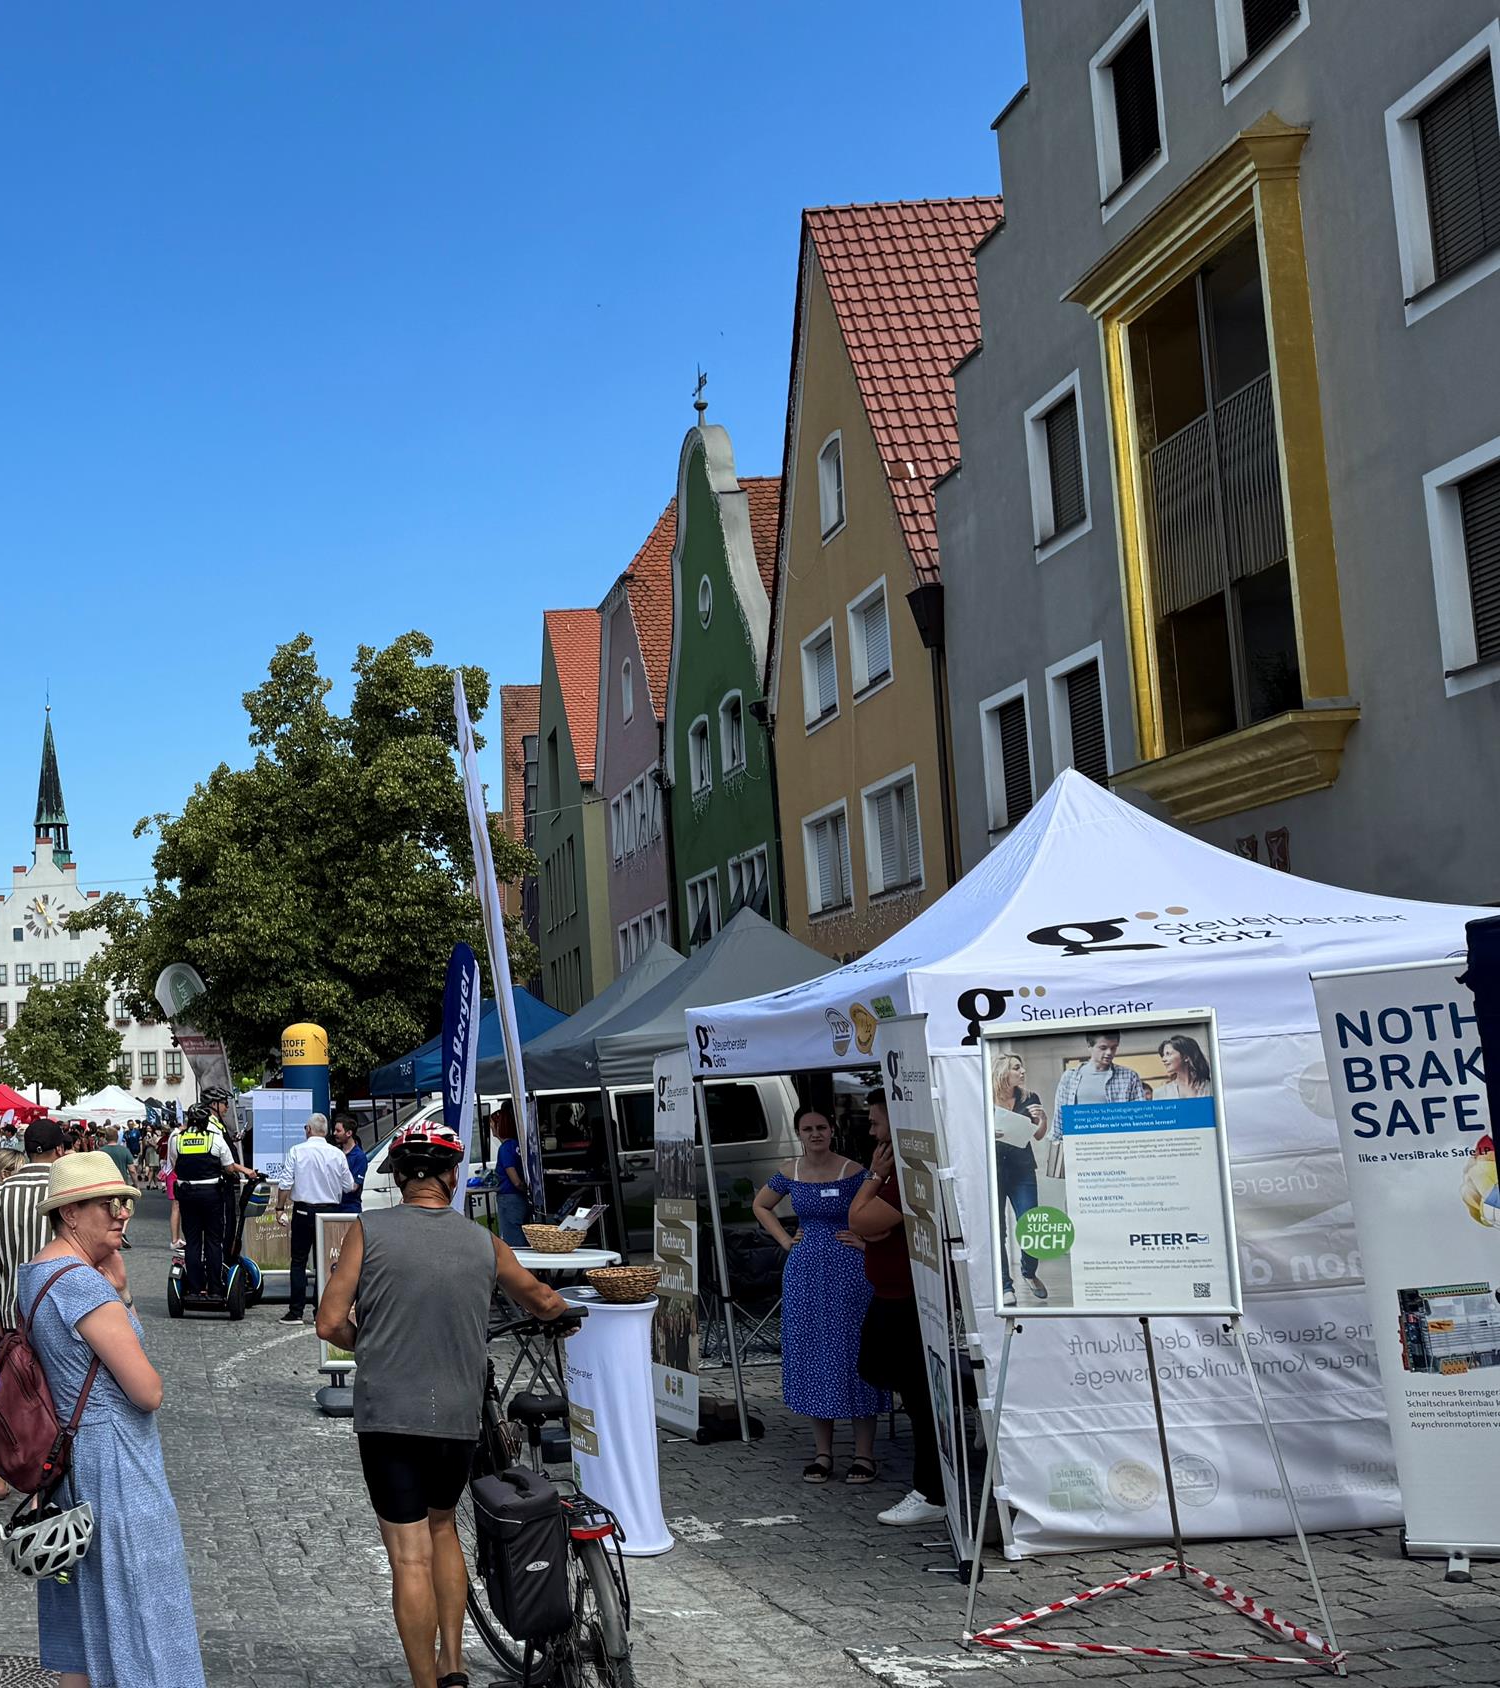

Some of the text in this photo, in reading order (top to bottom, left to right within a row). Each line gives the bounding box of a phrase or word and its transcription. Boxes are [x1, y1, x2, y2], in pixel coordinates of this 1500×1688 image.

[1153, 911, 1408, 936] Steuerberater
[1178, 928, 1284, 946] Götz
[1343, 1046, 1486, 1093] BRAK
[1358, 1153, 1379, 1163] like
[1390, 1148, 1449, 1161] VersiBrake
[1451, 1147, 1476, 1157] Safe
[1027, 1213, 1049, 1223] WIR
[1027, 1223, 1072, 1233] SUCHEN
[661, 1231, 686, 1255] Richtung
[1020, 1234, 1066, 1250] DICH
[1130, 1233, 1183, 1247] PETER
[1405, 1389, 1500, 1399] Unser neues Bremsger
[1407, 1399, 1494, 1408] Schaltschrankeinbau
[1411, 1420, 1491, 1430] Asynchronmotoren
